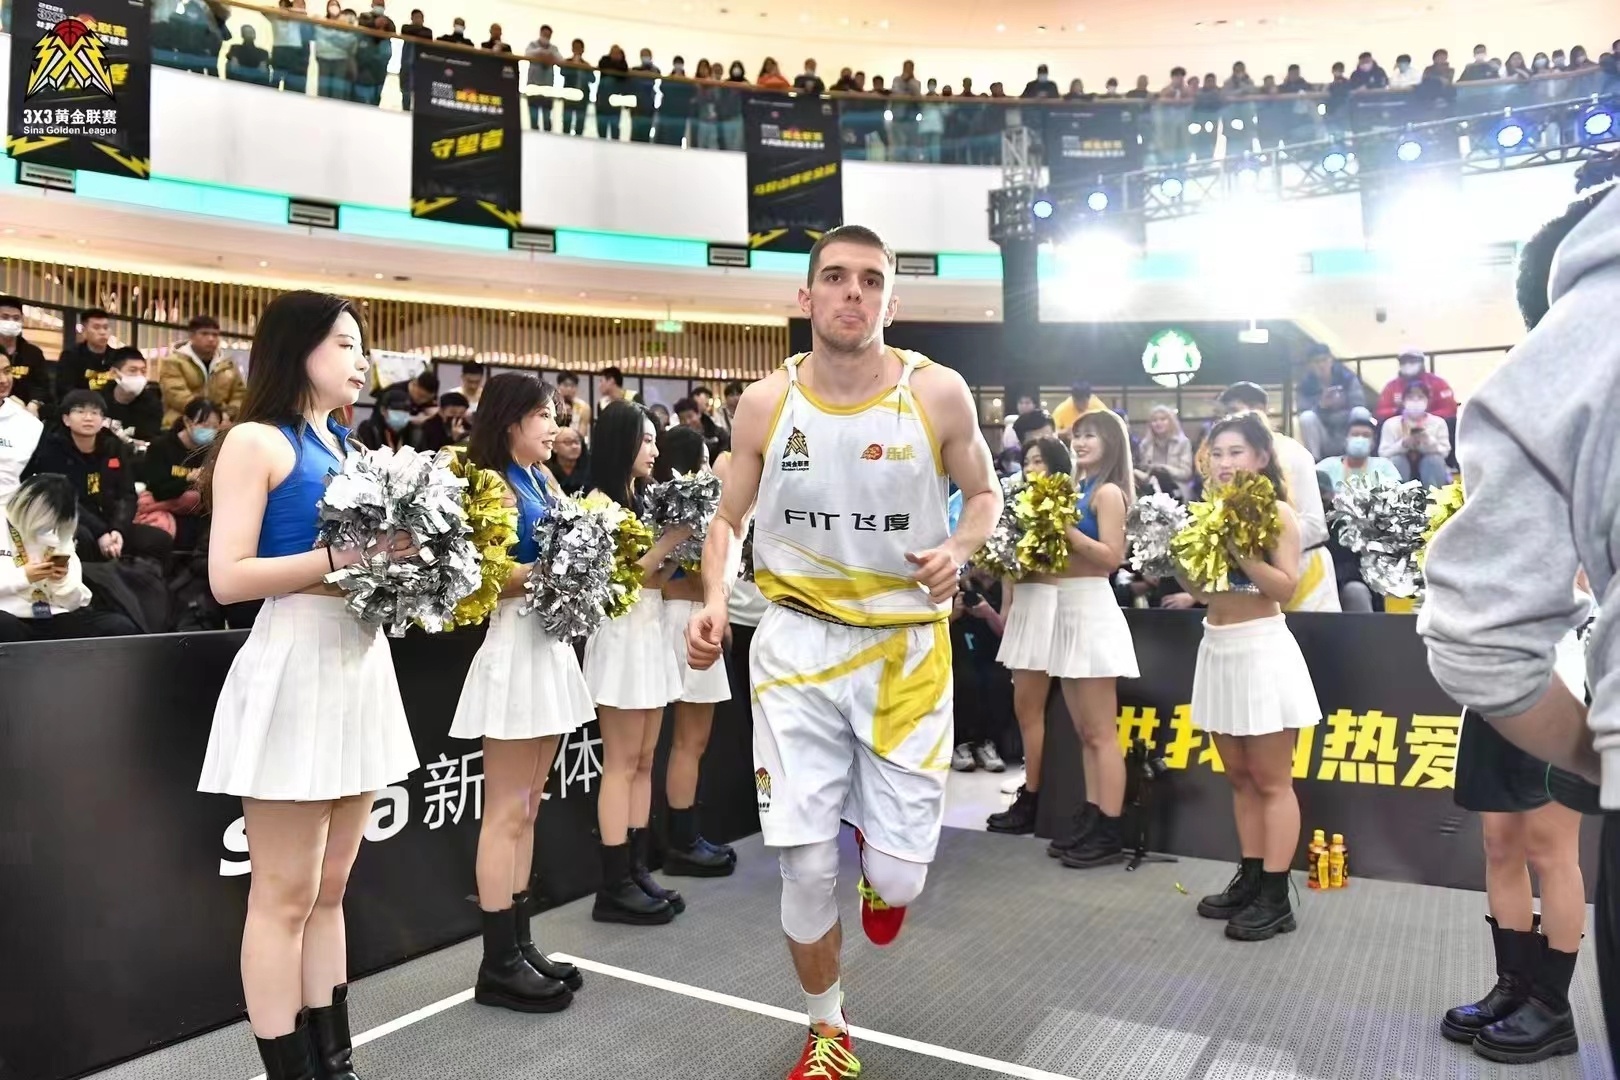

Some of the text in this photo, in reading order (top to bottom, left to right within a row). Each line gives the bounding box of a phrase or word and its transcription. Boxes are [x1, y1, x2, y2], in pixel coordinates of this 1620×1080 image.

[430, 128, 504, 160] 守望者
[784, 508, 910, 532] FIT 飞度
